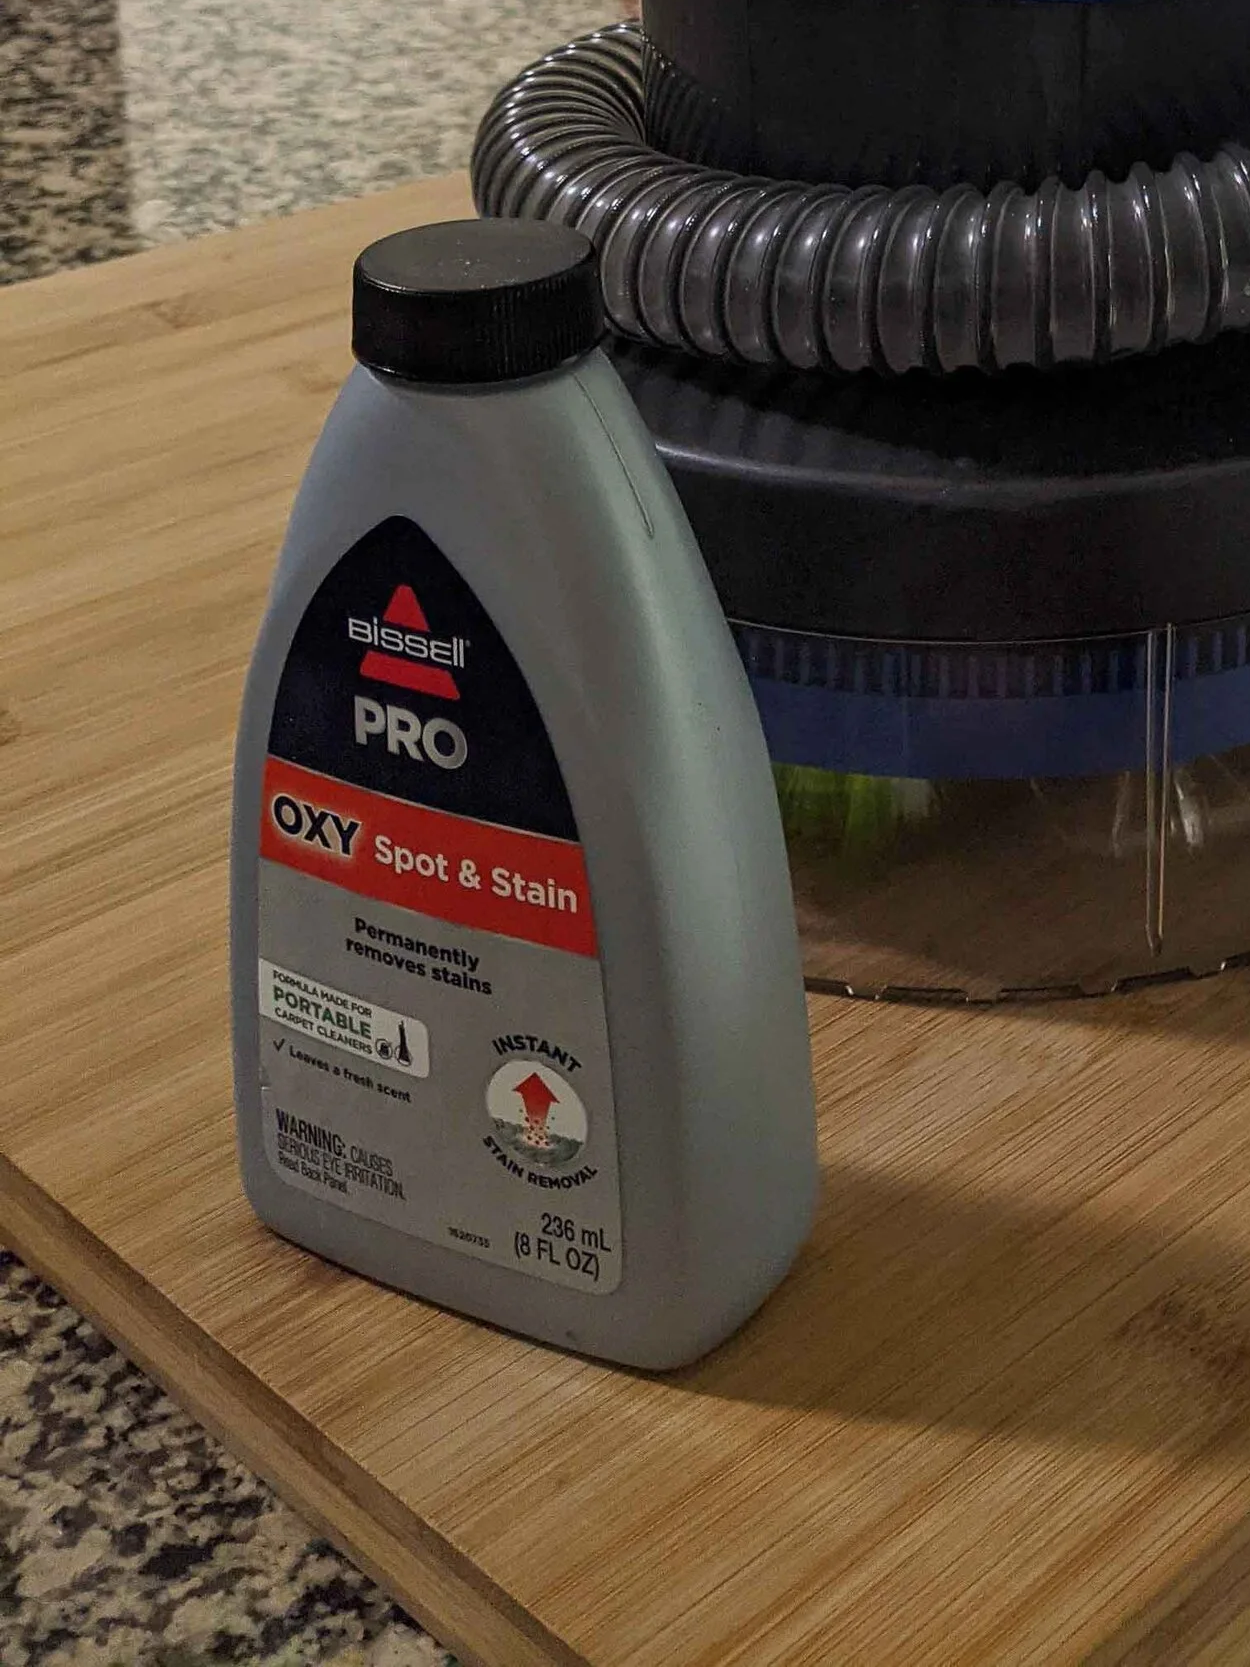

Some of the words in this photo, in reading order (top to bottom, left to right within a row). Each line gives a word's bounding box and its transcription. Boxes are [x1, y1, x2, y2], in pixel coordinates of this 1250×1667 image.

[354, 695, 468, 770] PRO
[271, 795, 361, 856] OXY
[374, 834, 449, 882] Spot
[458, 859, 481, 890] &
[491, 867, 578, 914] Stain
[346, 938, 426, 977] removes
[431, 966, 492, 995] stains
[354, 917, 479, 972] Permanently
[272, 985, 372, 1040] PORTABLE
[273, 969, 319, 997] FORMULA
[320, 991, 350, 1009] MADE
[351, 1003, 372, 1018] FOR
[274, 1007, 314, 1031] CARPET
[317, 1025, 373, 1055] CLEANERS
[492, 1035, 582, 1073] INSTANT
[289, 1045, 329, 1072] Leaves
[333, 1065, 341, 1075] a
[344, 1068, 374, 1088] fresh
[377, 1083, 411, 1102] scent
[276, 1108, 346, 1158] WARNING:
[351, 1145, 393, 1177] CAUSES
[277, 1133, 320, 1166] SERIOUS
[323, 1152, 342, 1175] EYE
[482, 1135, 525, 1178] STAIN
[527, 1165, 598, 1190] REMOVAL
[515, 1231, 530, 1259] (8
[537, 1238, 560, 1265] FL
[566, 1247, 600, 1282] OZ)
[541, 1212, 575, 1242] 236
[581, 1228, 611, 1252] mL
